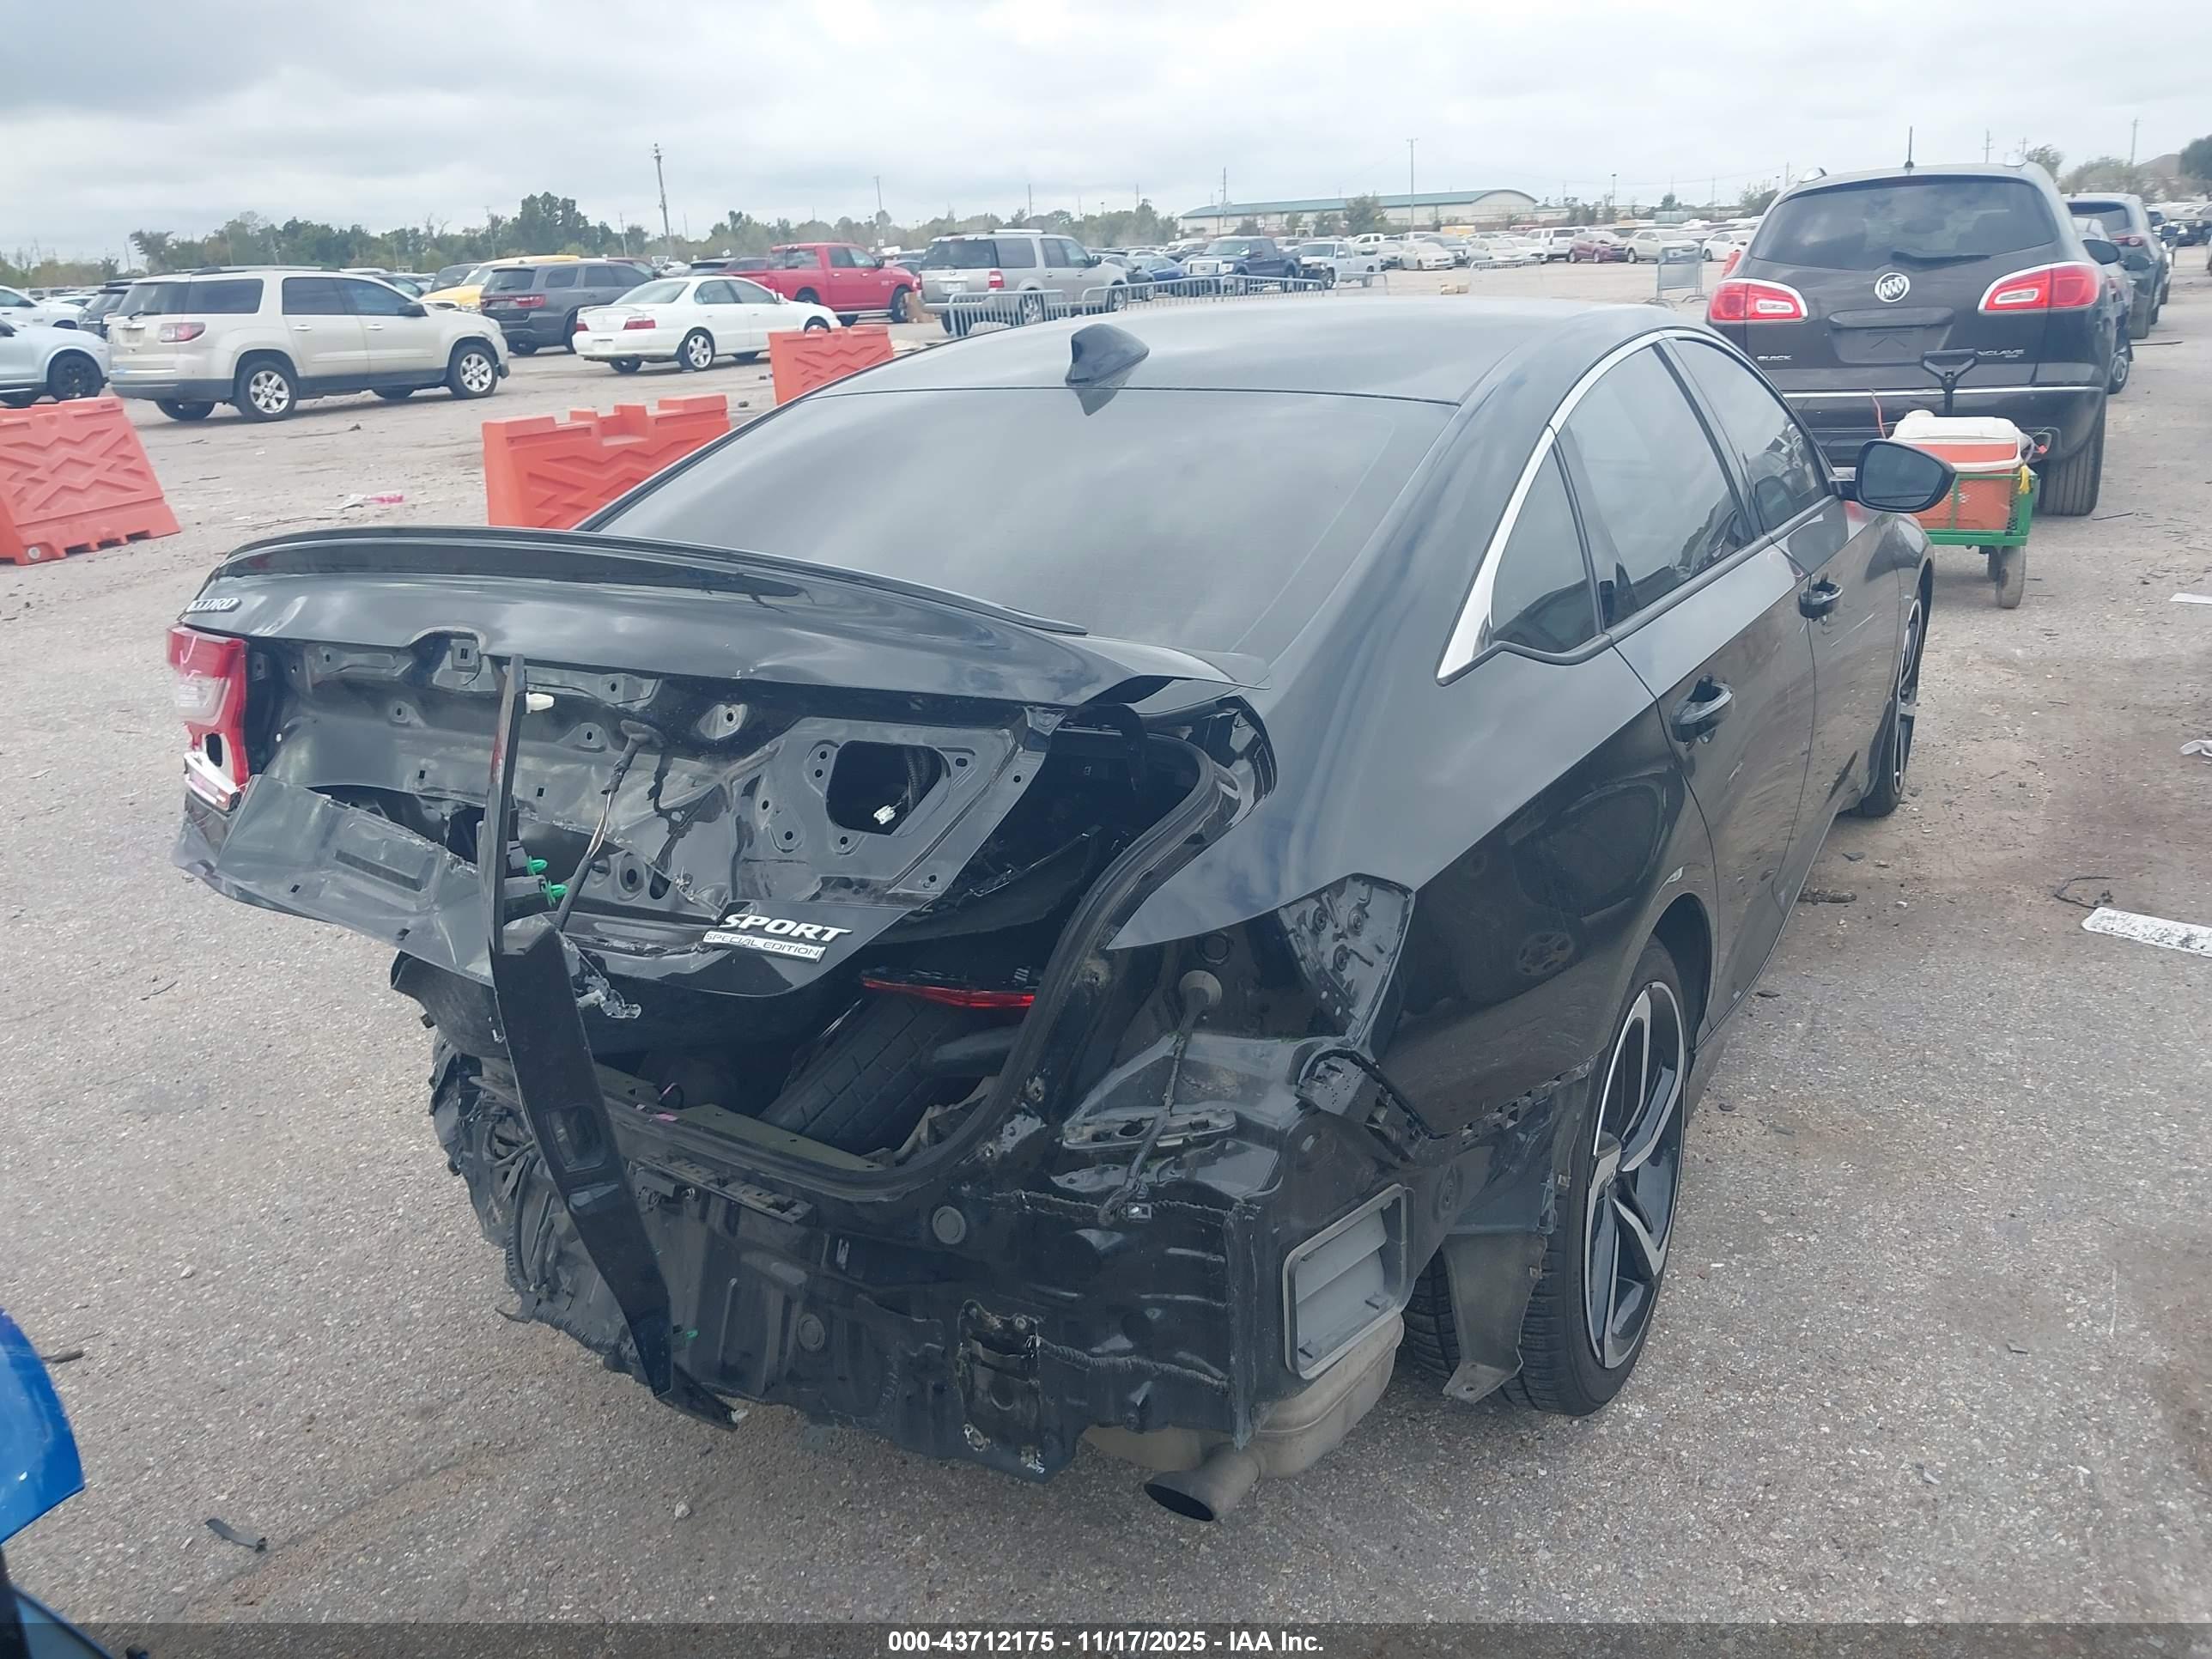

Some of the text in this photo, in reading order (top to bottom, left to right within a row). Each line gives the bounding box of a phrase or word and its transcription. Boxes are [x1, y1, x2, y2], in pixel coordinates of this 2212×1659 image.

[719, 913, 853, 943] SPORT
[704, 933, 820, 957] SPECIAL EDITION
